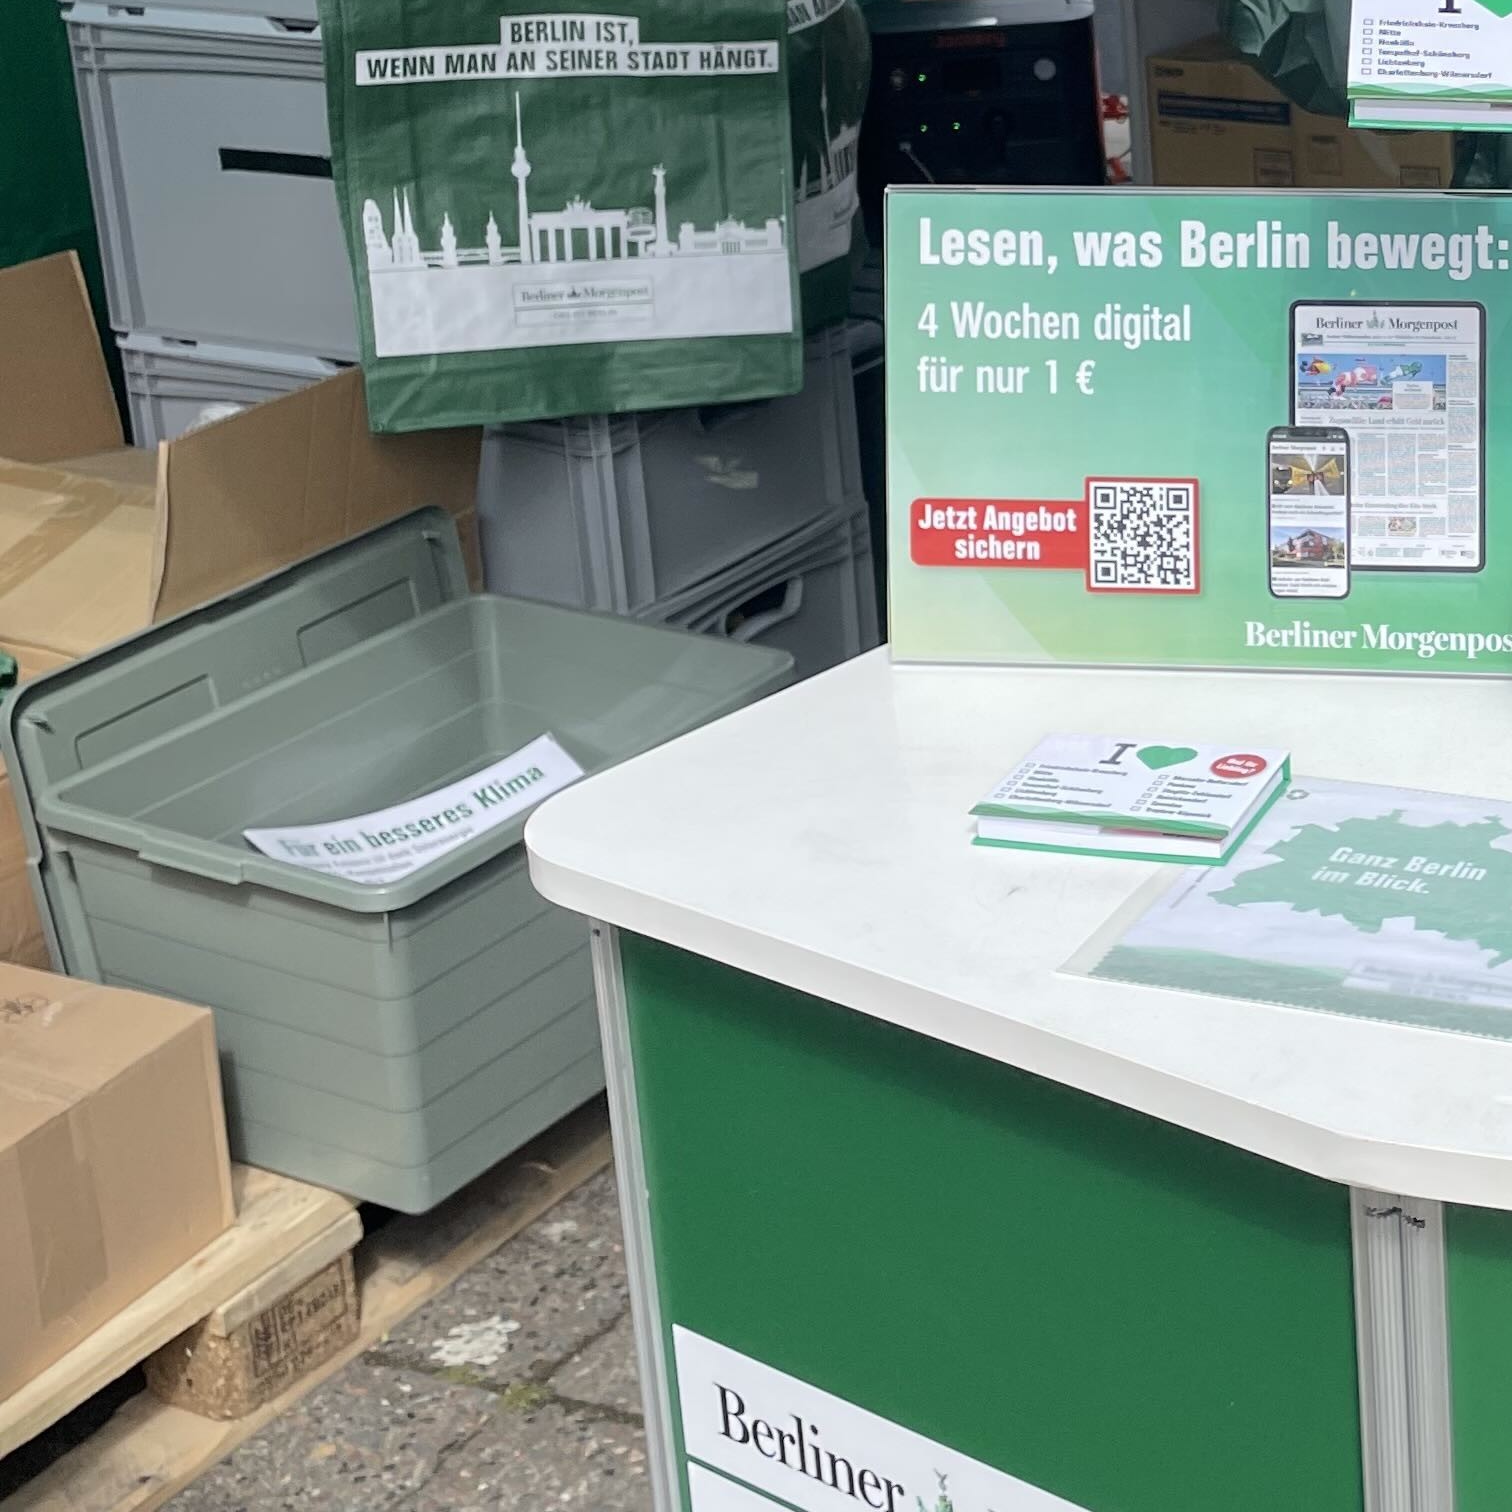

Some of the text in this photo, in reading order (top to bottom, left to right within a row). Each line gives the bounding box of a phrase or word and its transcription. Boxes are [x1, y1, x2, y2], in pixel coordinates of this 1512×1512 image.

[510, 21, 635, 47] BERLIN IST,
[367, 45, 773, 78] WENN MAN AN SEINER STADT HÄNGT.
[919, 217, 1509, 281] Lesen, was Berlin bewegt:
[917, 301, 1191, 350] 4 Wochen digital
[1315, 315, 1458, 332] Berliner Morgenpost
[917, 356, 1096, 395] für nur 1 €
[917, 504, 1078, 534] Jetzt Angebot
[954, 533, 1041, 562] sichern
[1244, 620, 1357, 649] Berliner
[1098, 743, 1138, 765] I
[323, 833, 364, 856] ein
[359, 802, 473, 849] besseres
[472, 764, 545, 810] Klima
[1329, 846, 1487, 880] Ganz Berlin
[1312, 866, 1430, 894] im Blick.
[712, 1381, 905, 1512] Berliner
